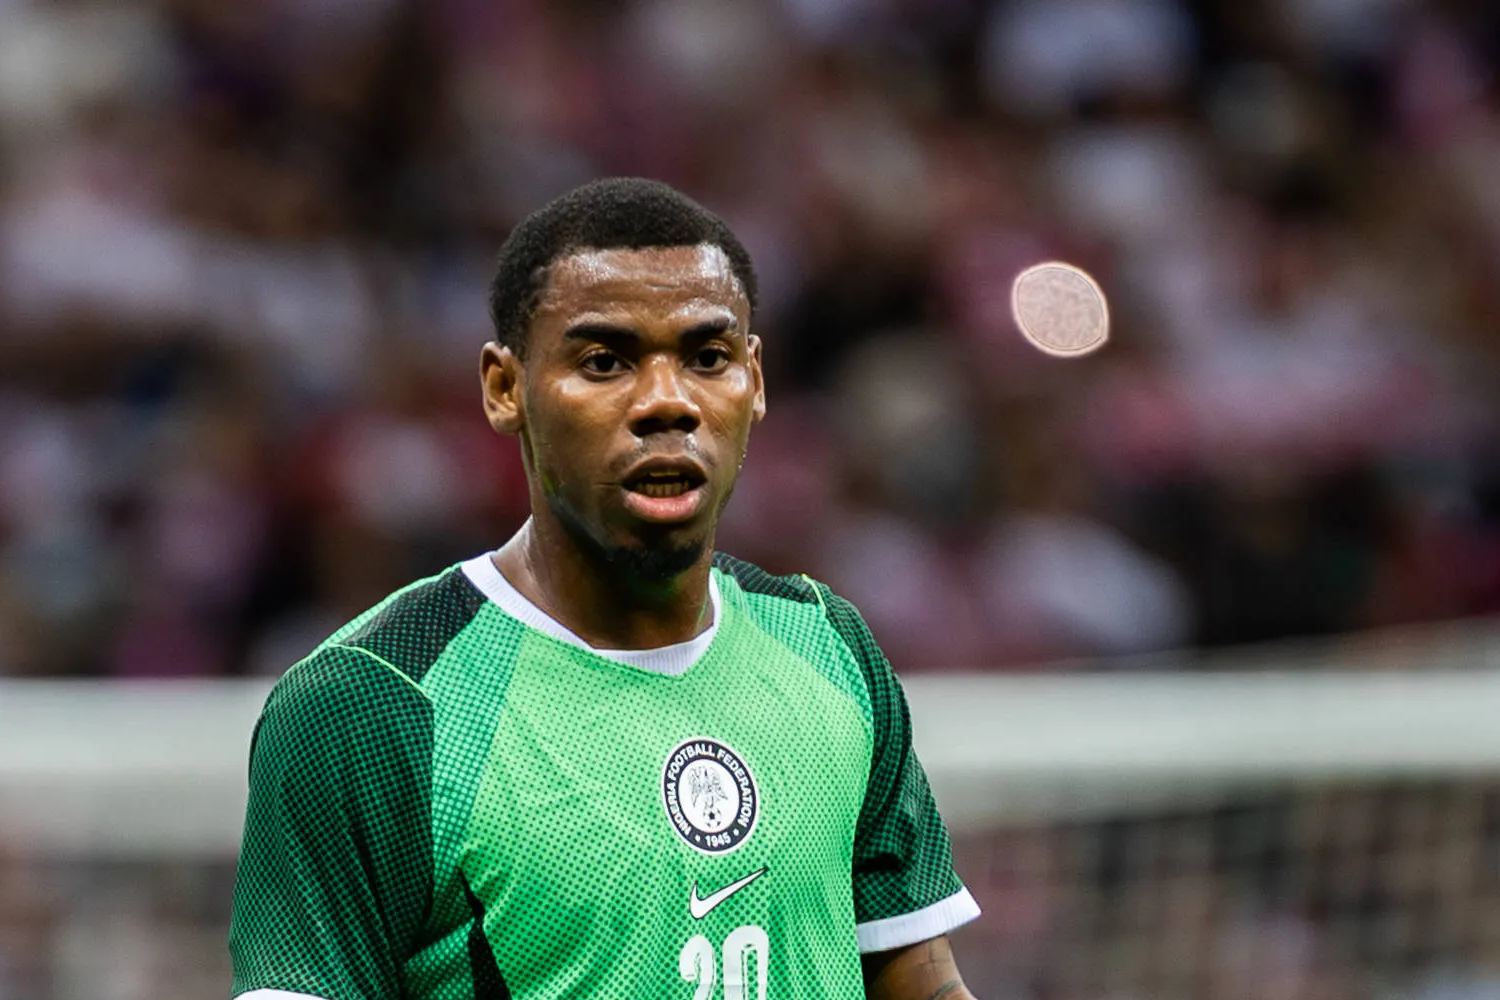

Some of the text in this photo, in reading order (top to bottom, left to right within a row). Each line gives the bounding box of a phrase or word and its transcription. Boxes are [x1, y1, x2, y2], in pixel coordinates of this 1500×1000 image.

[666, 743, 716, 782] FOOTBALL
[716, 748, 754, 829] FEDERATION
[705, 832, 732, 848] 1945
